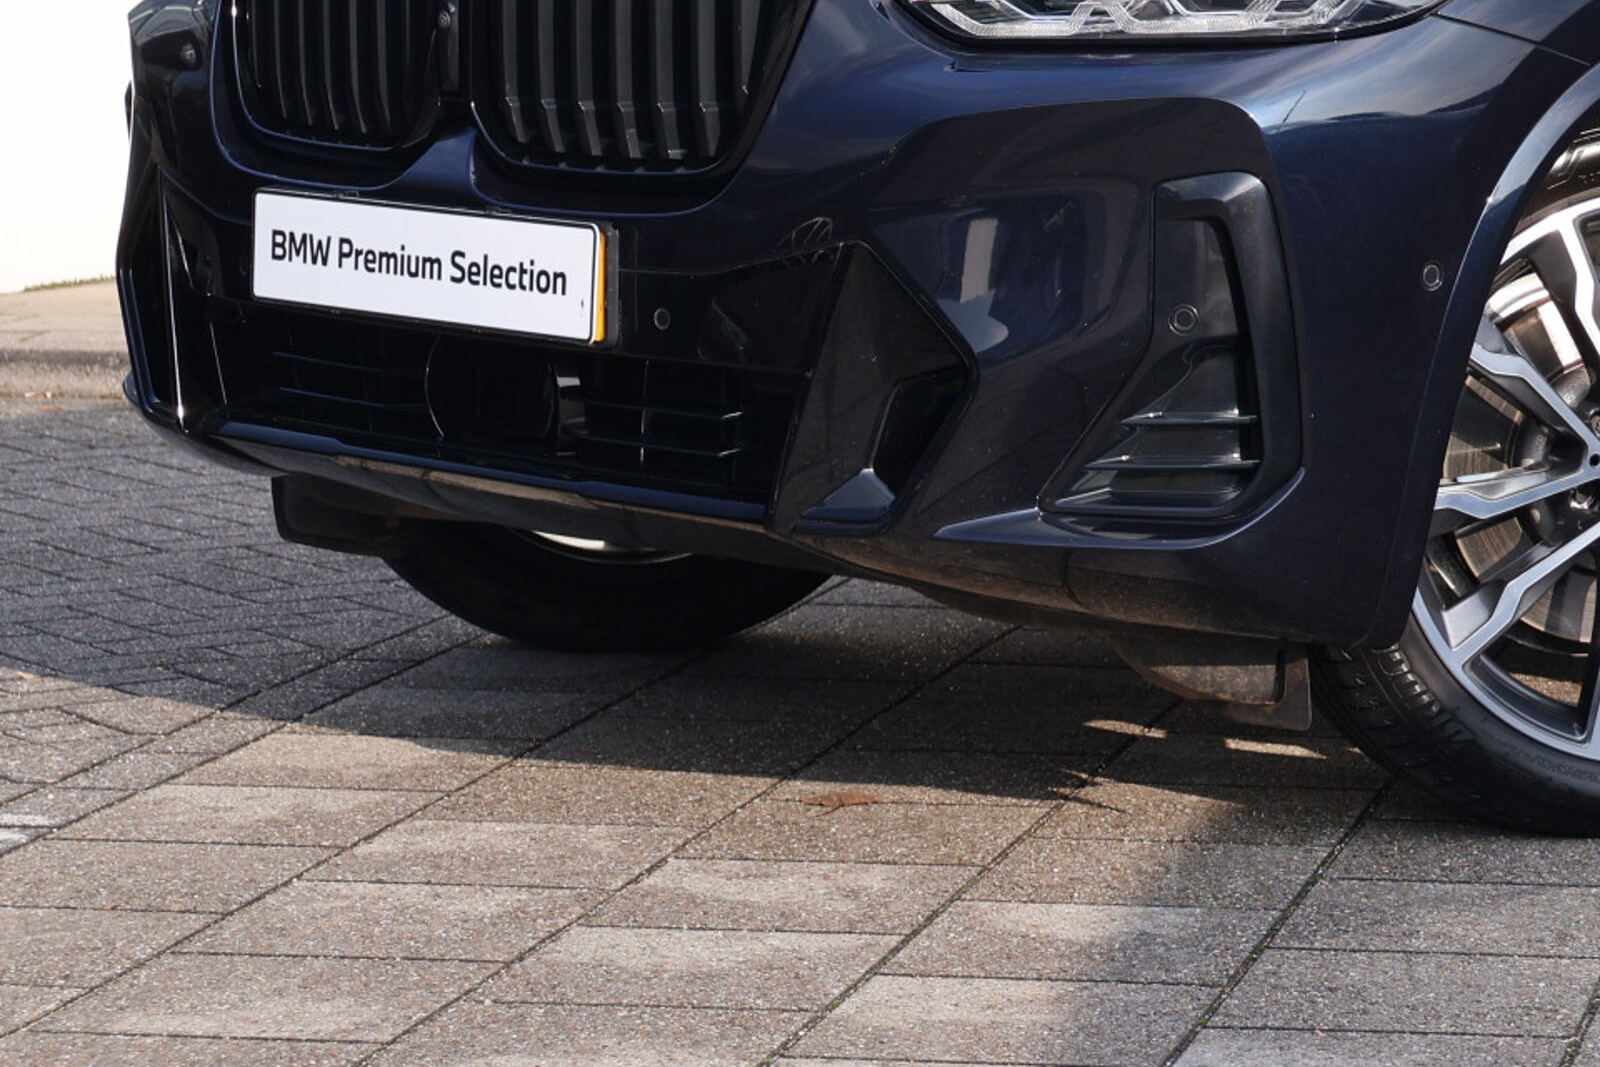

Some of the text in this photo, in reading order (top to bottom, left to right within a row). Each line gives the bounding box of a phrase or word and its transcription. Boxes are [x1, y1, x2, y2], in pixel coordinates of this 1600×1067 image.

[270, 230, 568, 296] BMW Premium Selection
